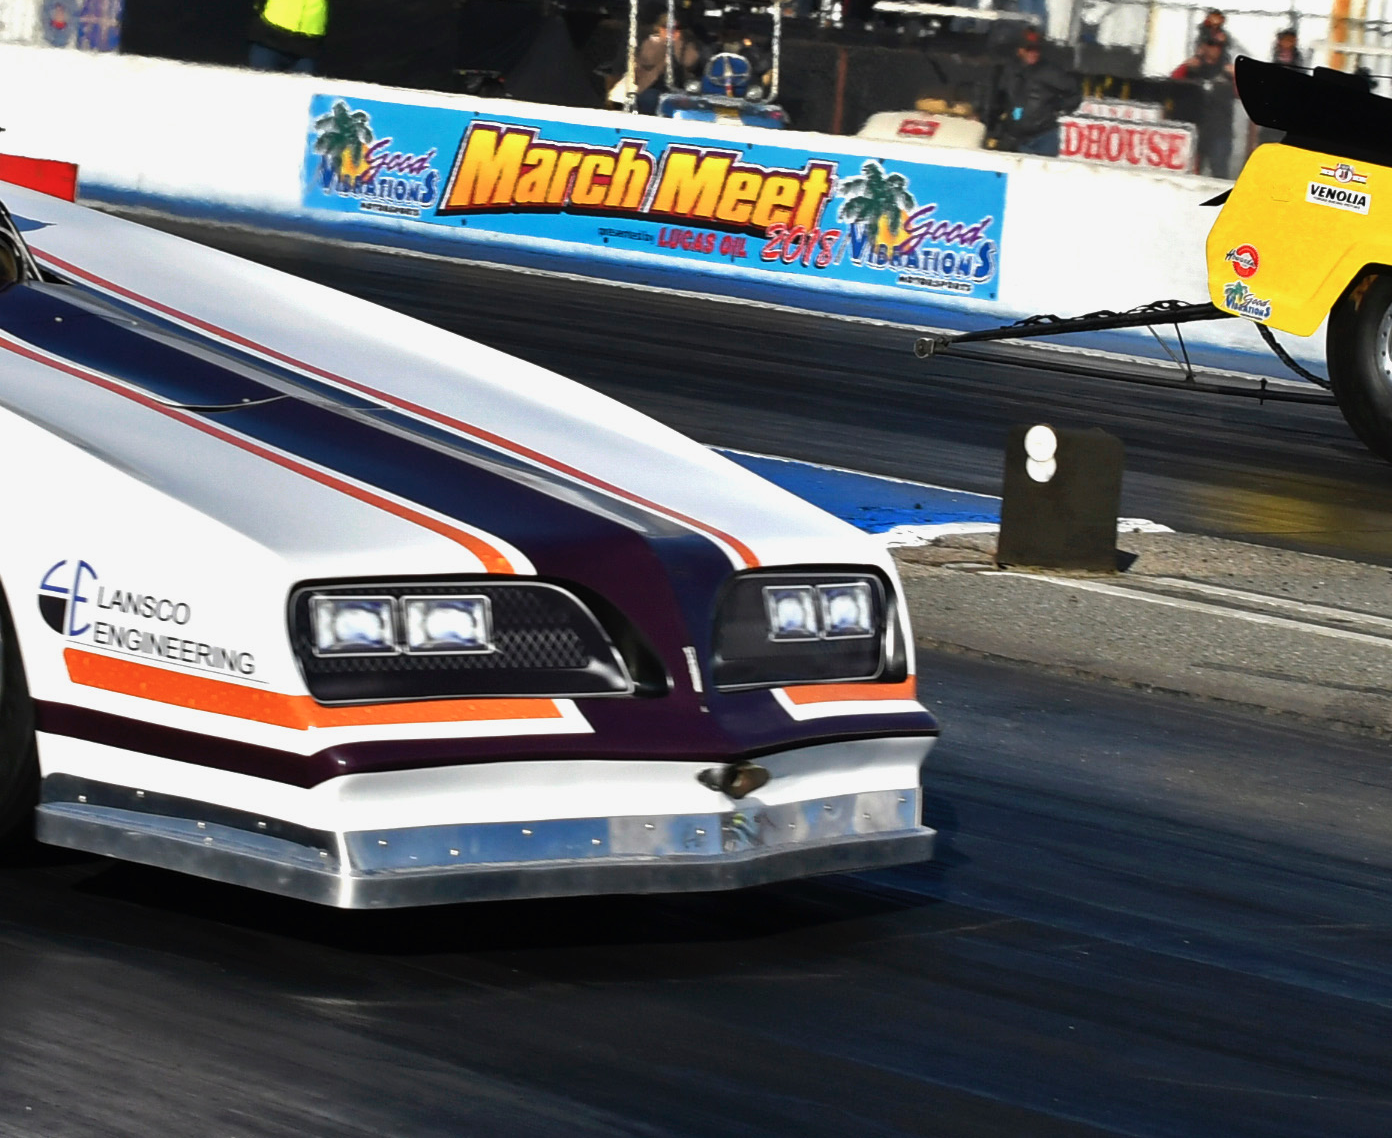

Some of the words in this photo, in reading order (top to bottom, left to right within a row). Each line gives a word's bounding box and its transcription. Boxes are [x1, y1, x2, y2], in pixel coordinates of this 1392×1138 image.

[365, 137, 437, 183] Good
[442, 120, 659, 214] March
[650, 143, 836, 231] Meet
[1310, 183, 1367, 207] VENOLIA
[657, 226, 717, 254] LUCAS
[719, 234, 748, 258] OIL
[762, 222, 842, 267] 2018
[903, 205, 993, 255] Good
[96, 585, 191, 625] LANSCO
[93, 622, 257, 676] ENGINEERING
